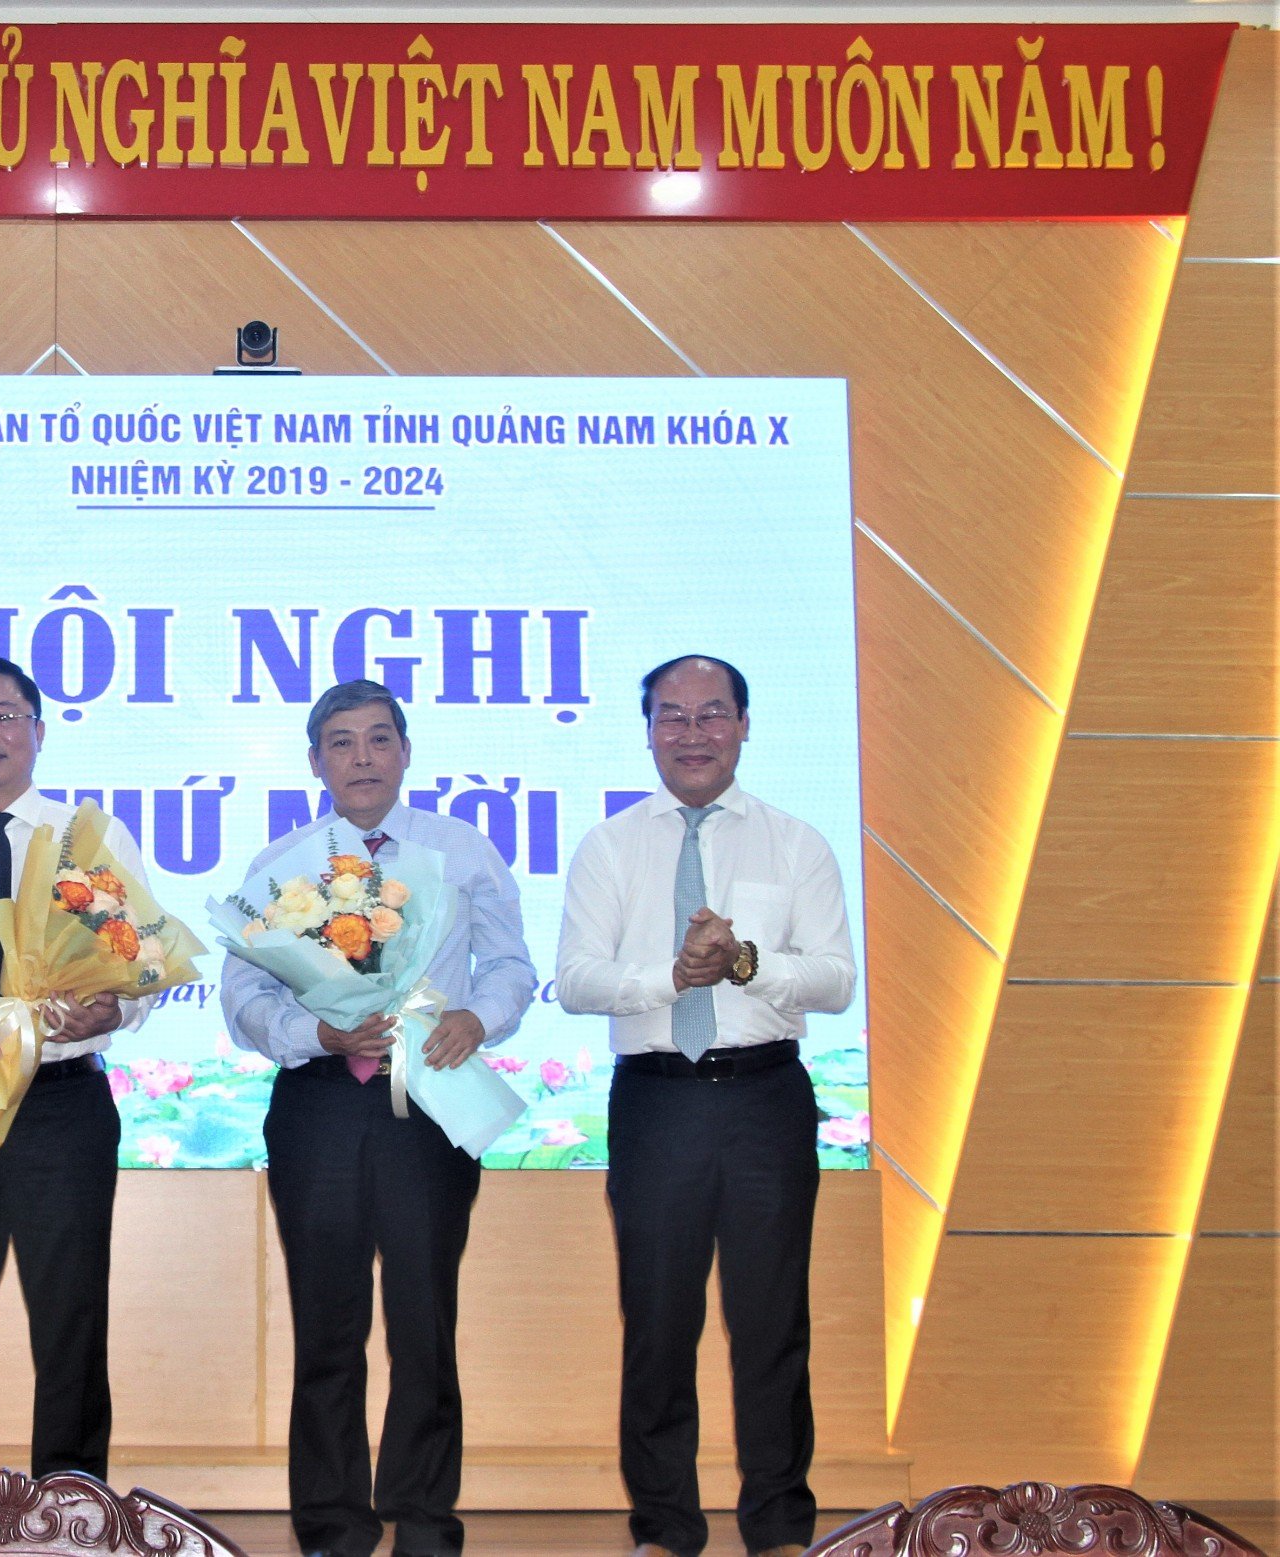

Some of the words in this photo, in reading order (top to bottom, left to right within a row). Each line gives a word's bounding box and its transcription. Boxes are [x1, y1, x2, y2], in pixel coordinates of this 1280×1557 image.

[50, 36, 310, 166] NGHĨA
[311, 35, 505, 192] VIỆT
[522, 64, 703, 168] NAM
[716, 36, 934, 172] MUÔN
[40, 401, 81, 443] TỔ
[92, 401, 181, 446] QUỐC
[193, 407, 262, 449] VIỆT
[274, 413, 351, 444] NAM
[363, 404, 439, 444] TỈNH
[452, 404, 565, 447] QUẢNG
[578, 415, 655, 445] NAM
[667, 406, 757, 445] KHÓA
[768, 416, 789, 445] X
[71, 460, 181, 501] NHIỆM
[194, 459, 235, 495] KỲ
[247, 465, 328, 495] 2019
[363, 466, 444, 496] 2024
[232, 607, 591, 724] NGHỊ
